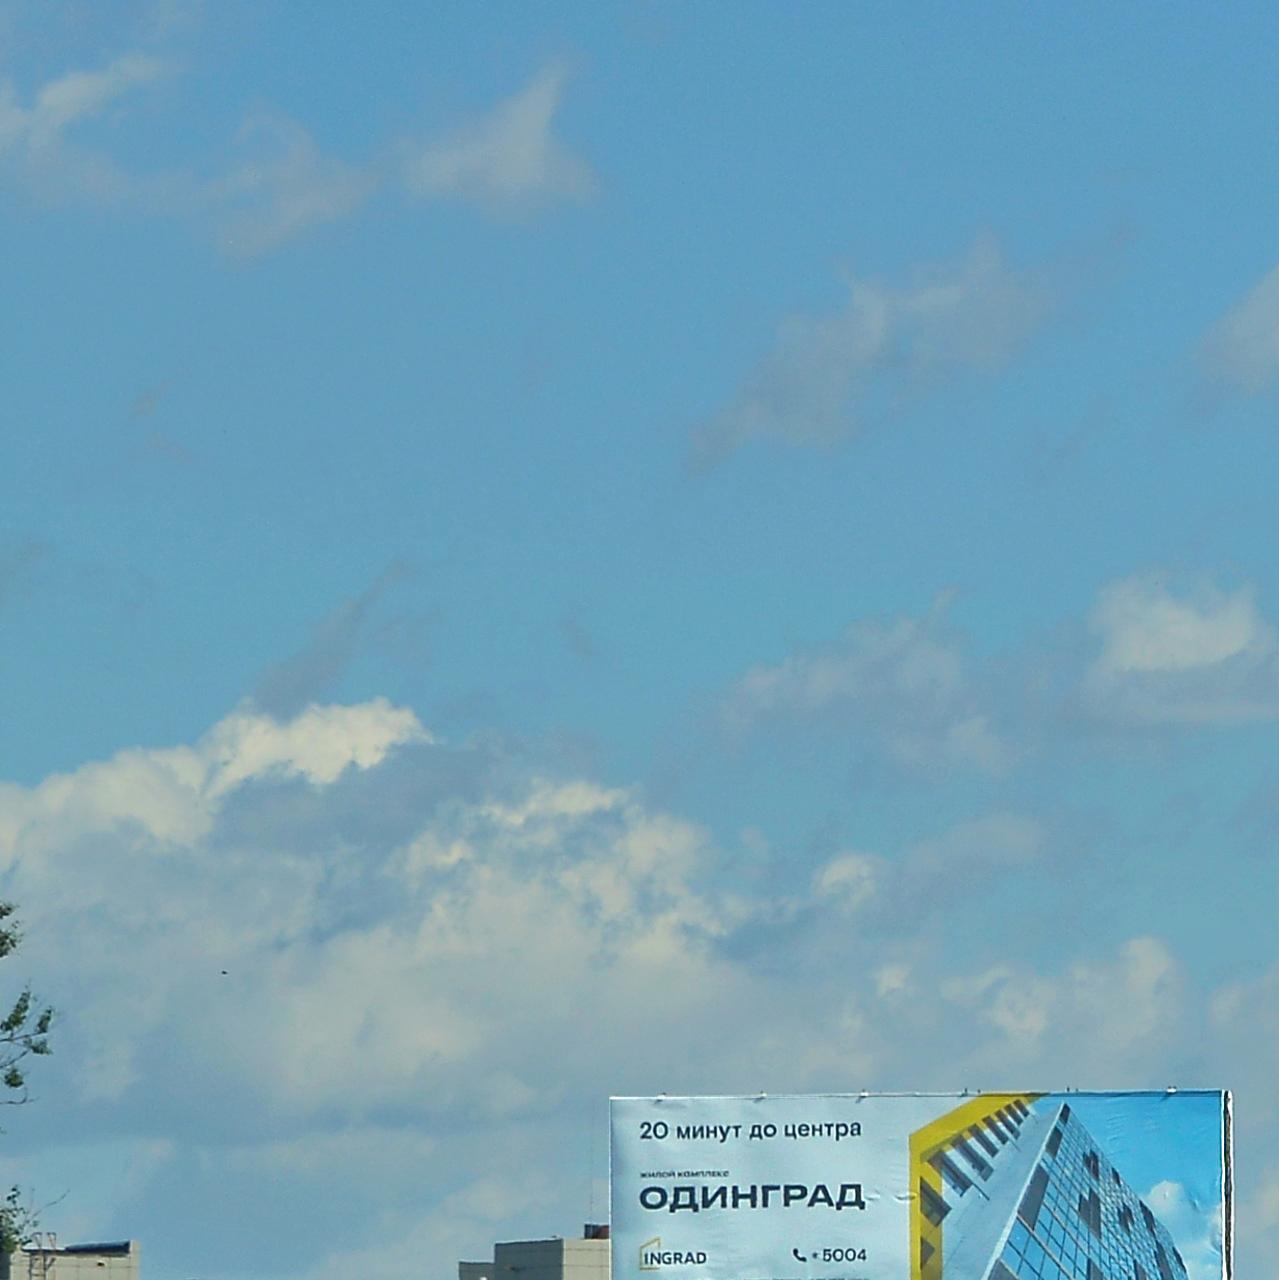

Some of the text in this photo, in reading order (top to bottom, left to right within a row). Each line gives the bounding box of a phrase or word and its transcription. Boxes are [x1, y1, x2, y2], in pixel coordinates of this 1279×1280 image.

[639, 1121, 862, 1143] 20 минут до центра
[639, 1183, 866, 1213] ОДИНГРАД
[643, 1251, 707, 1265] INGRAD
